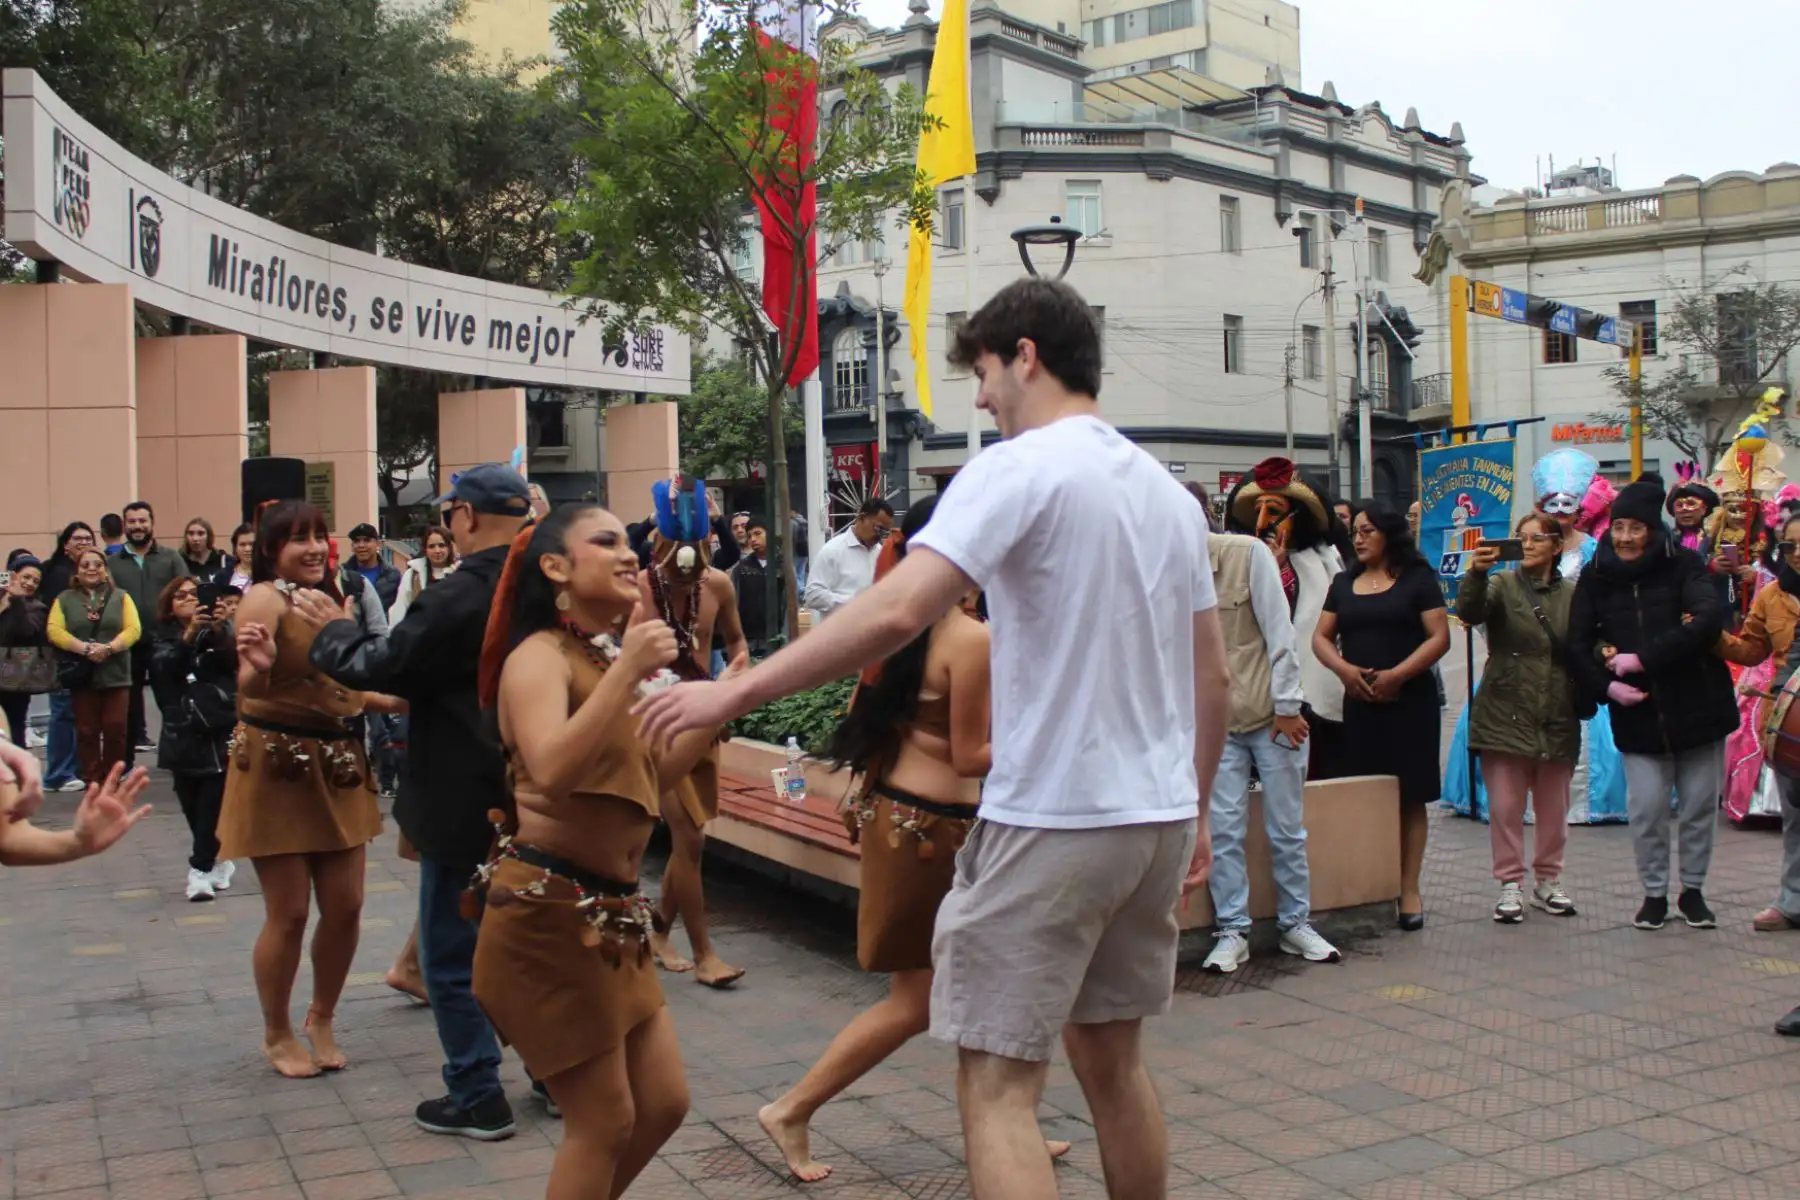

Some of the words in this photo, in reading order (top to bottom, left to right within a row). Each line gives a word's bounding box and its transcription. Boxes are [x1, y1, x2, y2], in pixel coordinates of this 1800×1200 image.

[208, 233, 356, 333] Miraflores,
[370, 297, 403, 334] se
[416, 299, 476, 346] vive
[488, 315, 575, 365] mejor
[837, 454, 864, 466] KFC
[1488, 481, 1511, 505] LIMA
